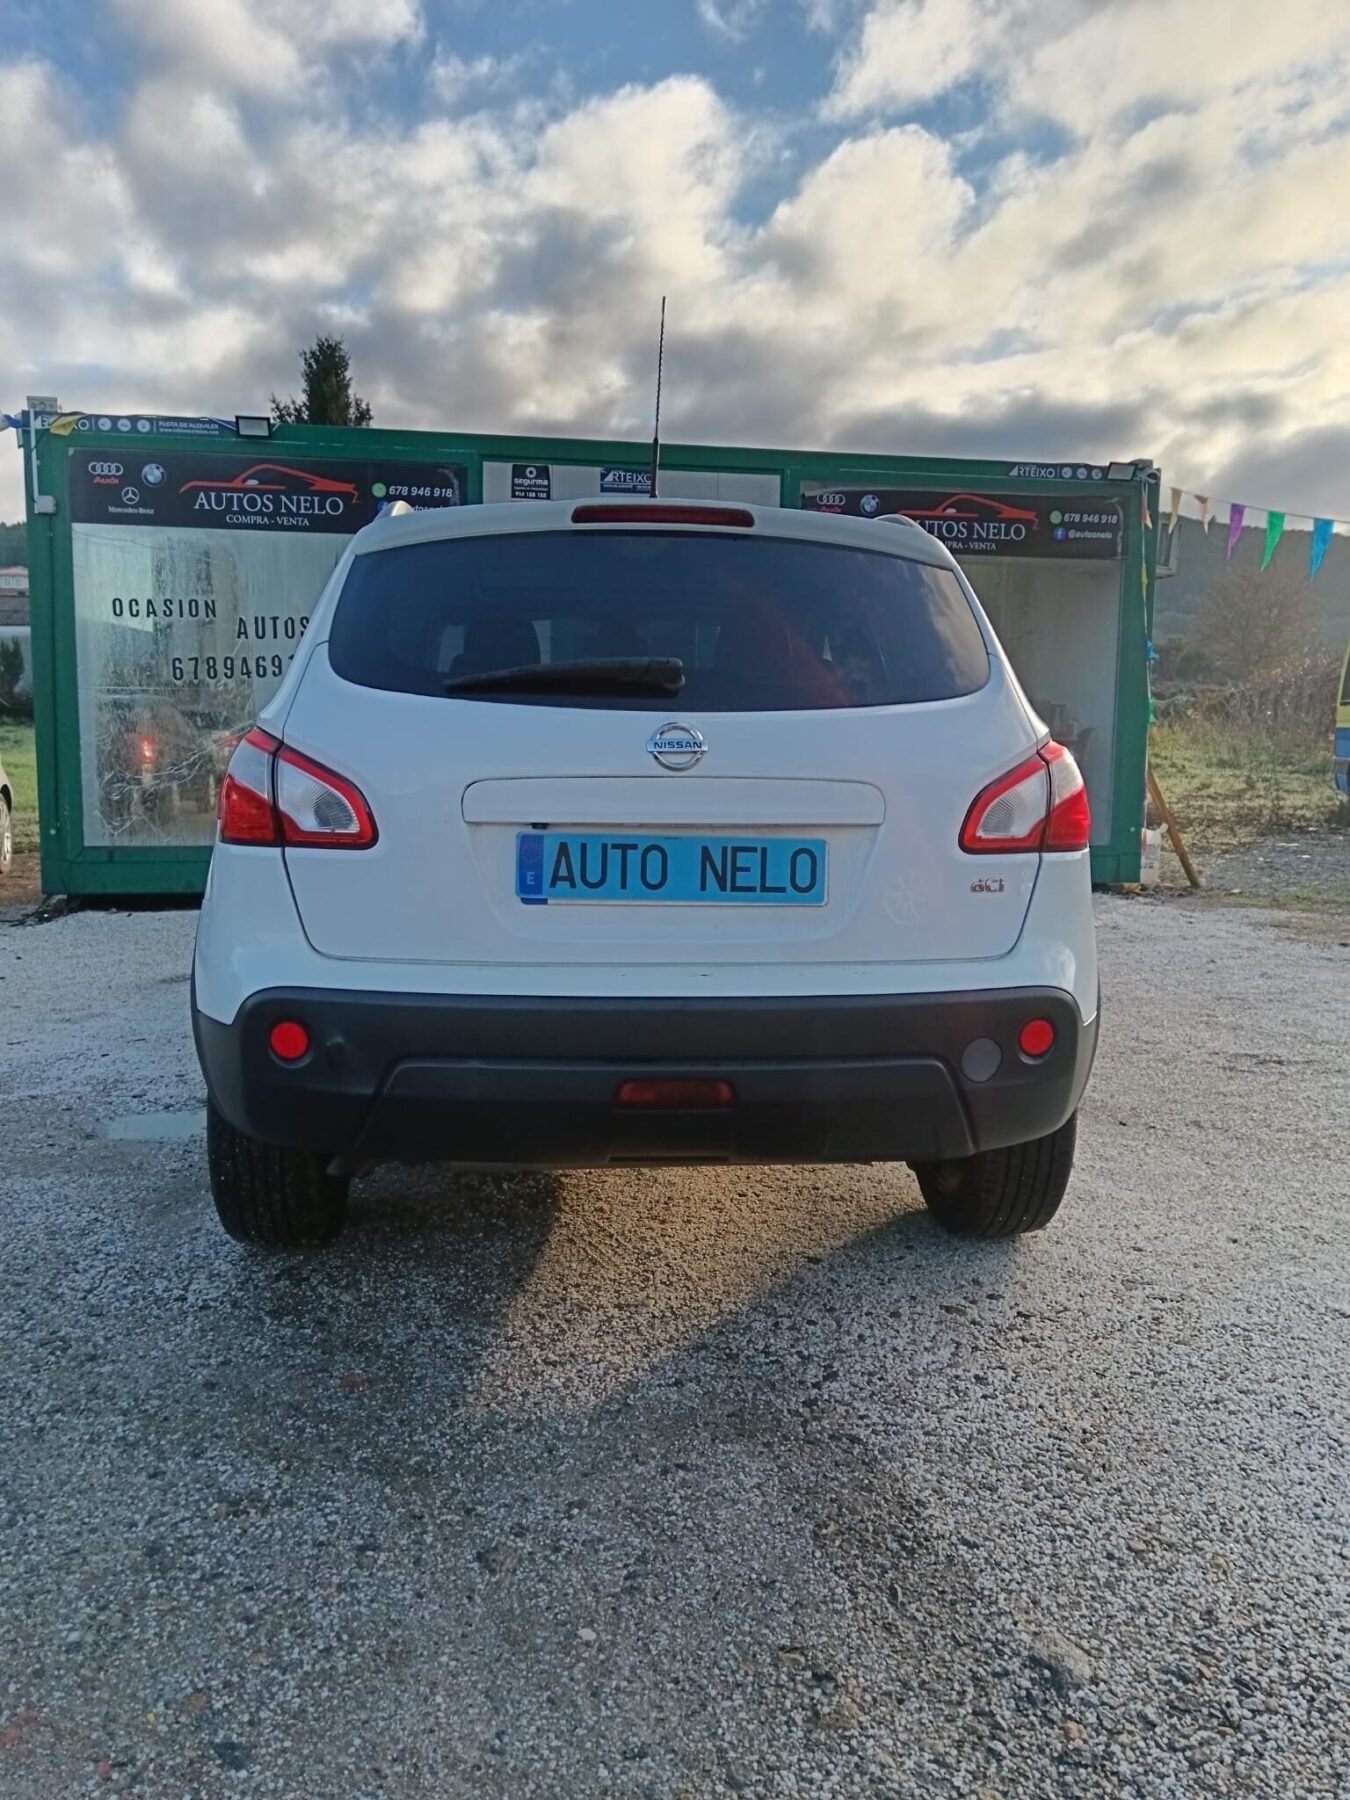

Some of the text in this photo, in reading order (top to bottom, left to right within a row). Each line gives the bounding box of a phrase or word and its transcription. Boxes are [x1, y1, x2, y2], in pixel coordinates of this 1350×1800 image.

[1008, 465, 1055, 478] ARTEIXO
[93, 475, 119, 485] Audi
[388, 485, 453, 498] 678 946 918
[193, 491, 344, 516] AUTOS NELO
[226, 514, 269, 525] COMPRA
[276, 516, 310, 527] VENTA
[1063, 512, 1118, 525] 678 946 918
[973, 522, 1026, 541] NELO
[969, 542, 997, 551] VENTA
[112, 598, 217, 618] OCASION
[236, 616, 310, 640] AUTOS
[171, 655, 295, 681] 6789469
[653, 741, 702, 749] NISSAN
[526, 841, 818, 894] E AUTO NELO
